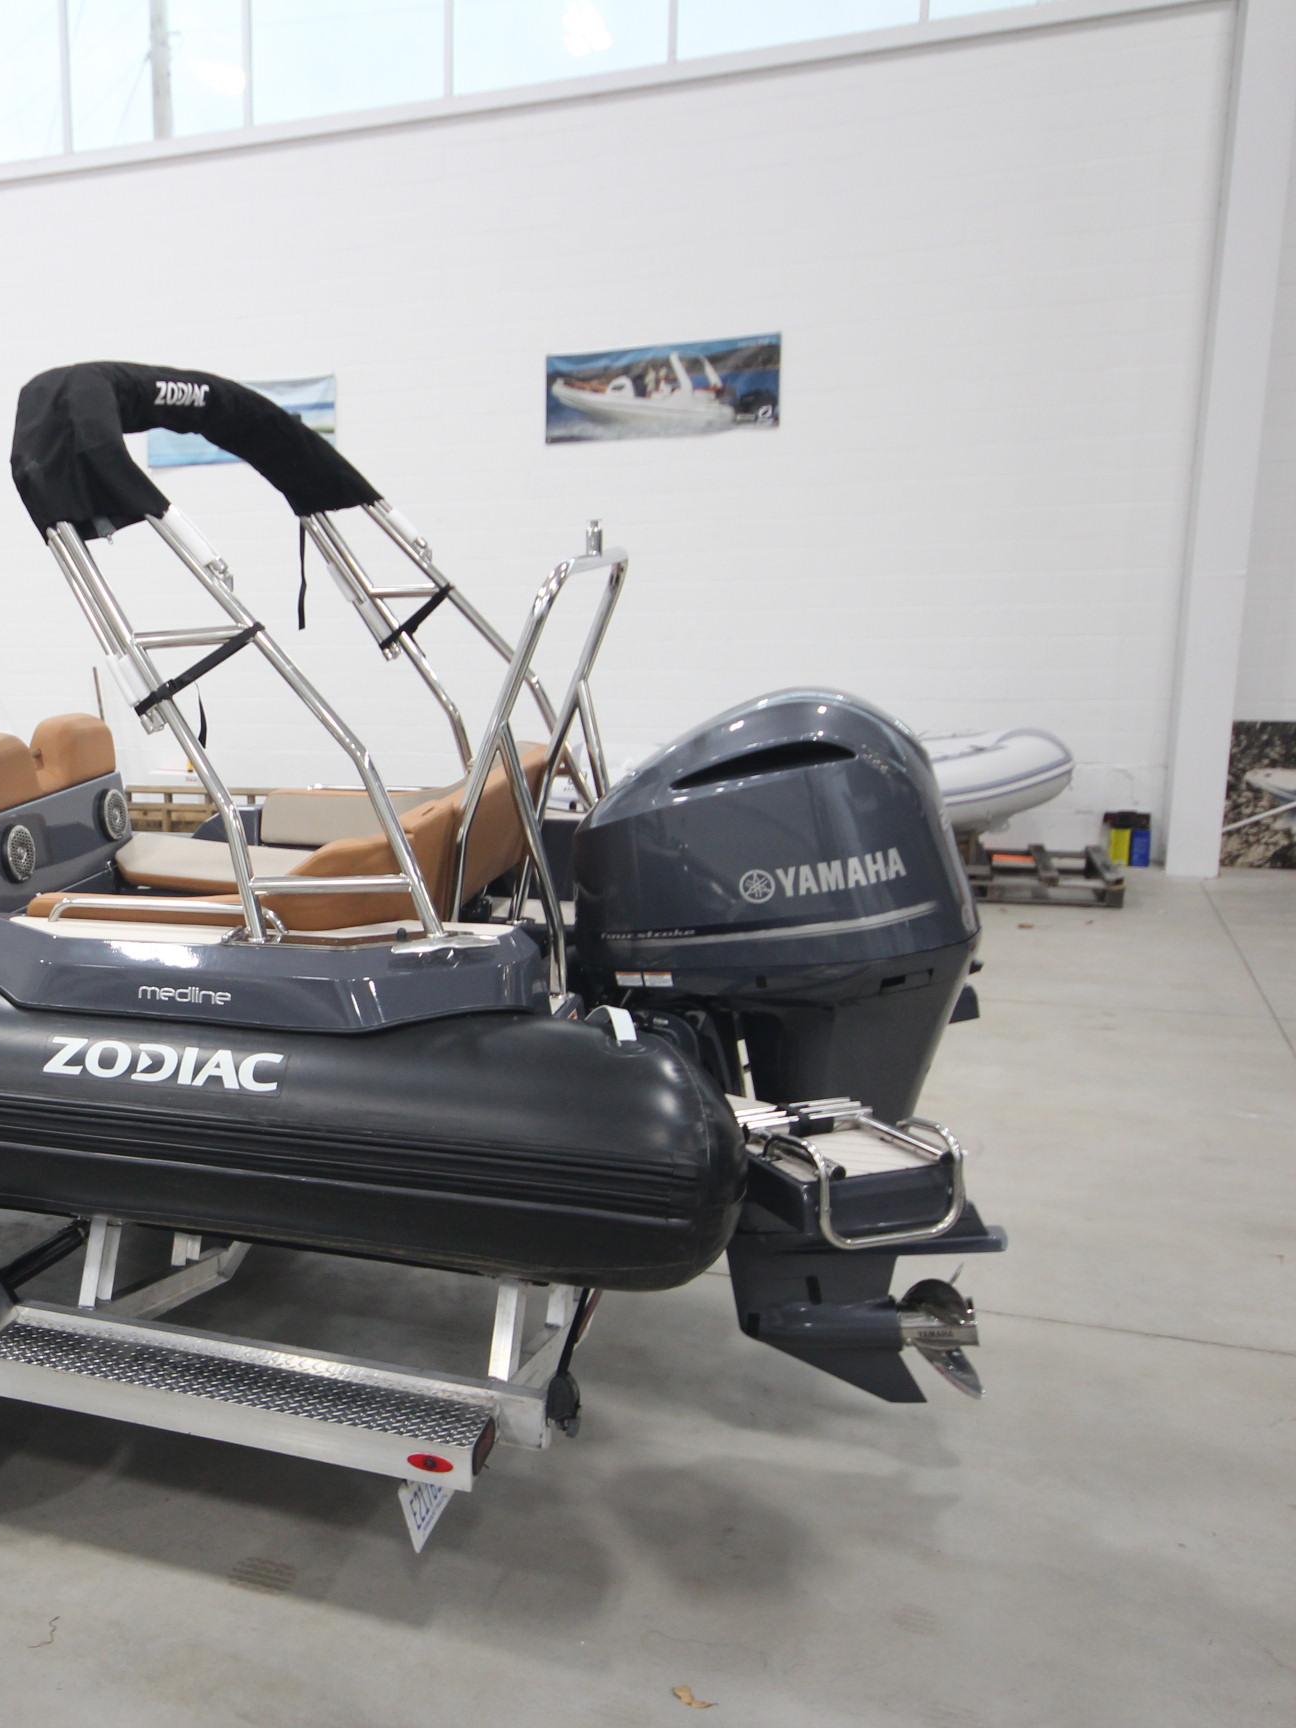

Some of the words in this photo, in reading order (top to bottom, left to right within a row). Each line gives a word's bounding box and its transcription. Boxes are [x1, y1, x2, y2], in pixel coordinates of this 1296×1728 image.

[154, 380, 210, 407] ZODIAC
[775, 847, 907, 898] YAMAHA
[138, 985, 232, 1006] medline
[43, 1036, 284, 1092] ZODIAC
